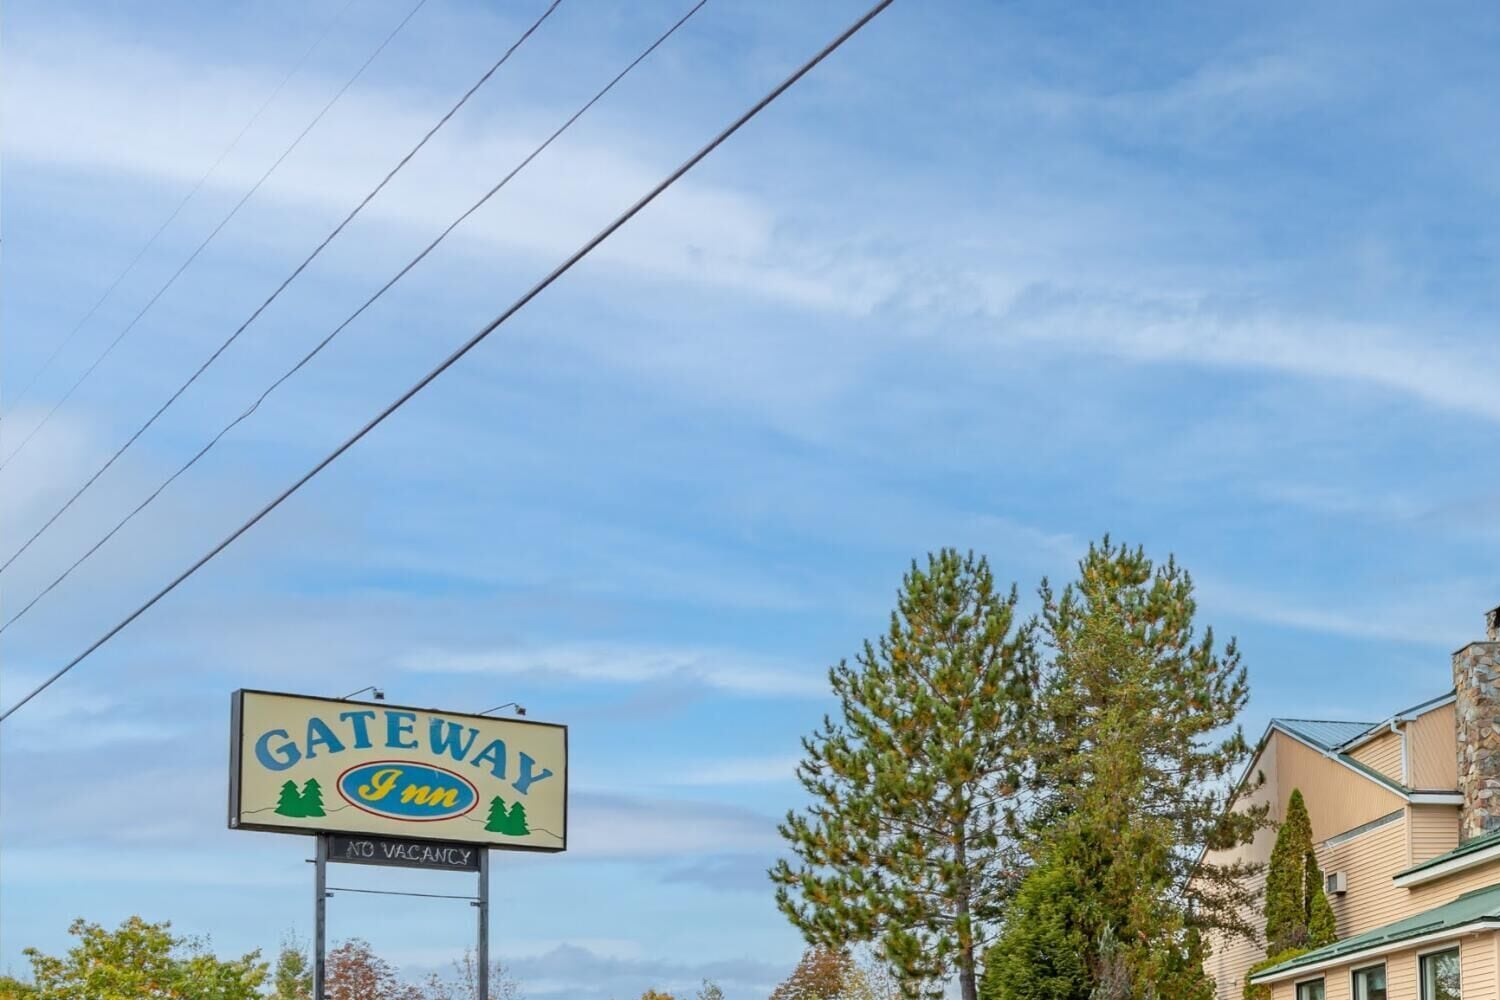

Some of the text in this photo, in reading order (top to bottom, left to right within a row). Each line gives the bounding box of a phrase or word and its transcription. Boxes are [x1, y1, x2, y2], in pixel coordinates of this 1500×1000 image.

[255, 711, 553, 795] GATEWAY
[358, 769, 460, 808] Inn
[346, 841, 471, 865] NO VACANCY
